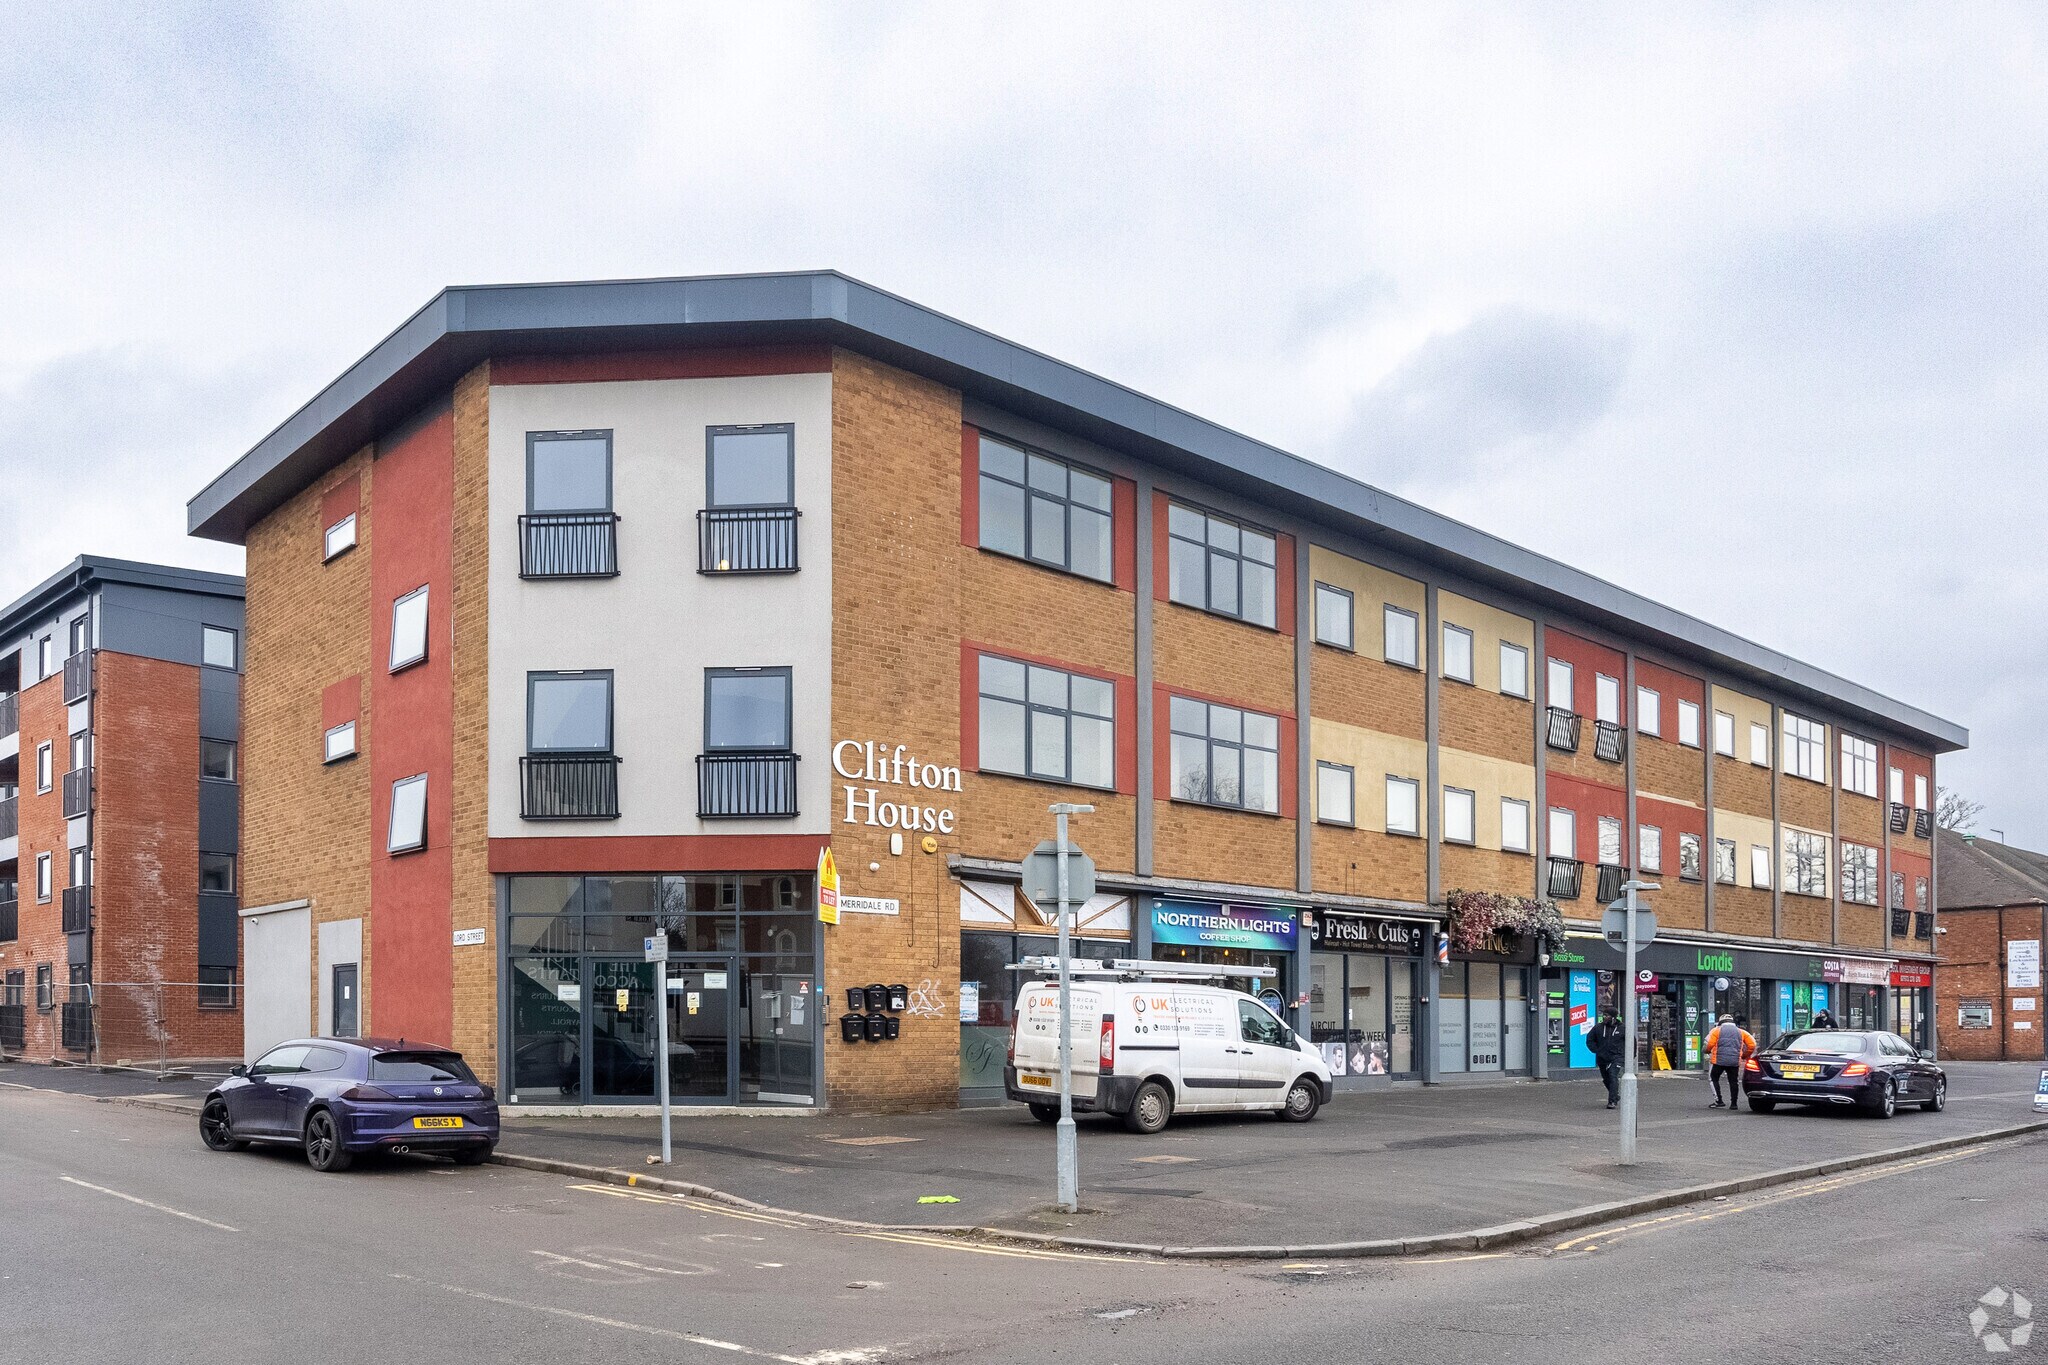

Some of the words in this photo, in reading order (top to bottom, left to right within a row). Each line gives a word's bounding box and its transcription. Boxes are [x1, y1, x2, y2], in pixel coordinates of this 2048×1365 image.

[832, 740, 963, 792] Clifton
[843, 785, 954, 834] House
[841, 899, 881, 910] MERRIDALE
[1157, 911, 1239, 930] NORTHERN
[1241, 919, 1290, 934] LIGHTS
[1325, 918, 1367, 940] Fresh
[1378, 922, 1409, 943] Cuts
[455, 933, 465, 942] LORD
[467, 931, 484, 941] STREET
[1199, 932, 1229, 942] COFFEE
[1230, 934, 1251, 942] SHOP
[1569, 952, 1585, 963] Stores
[1697, 948, 1733, 972] Londis
[1824, 961, 1840, 971] COSTA
[1573, 975, 1590, 985] Quality
[1578, 984, 1591, 993] Value
[1040, 997, 1055, 1007] UK
[1151, 998, 1169, 1011] UK
[1169, 997, 1214, 1005] ELECTRICAL
[1170, 1006, 1213, 1014] SOLUTIONS
[1571, 1009, 1586, 1020] JACK'S
[1366, 1032, 1386, 1041] WEEK
[451, 1118, 457, 1127] X
